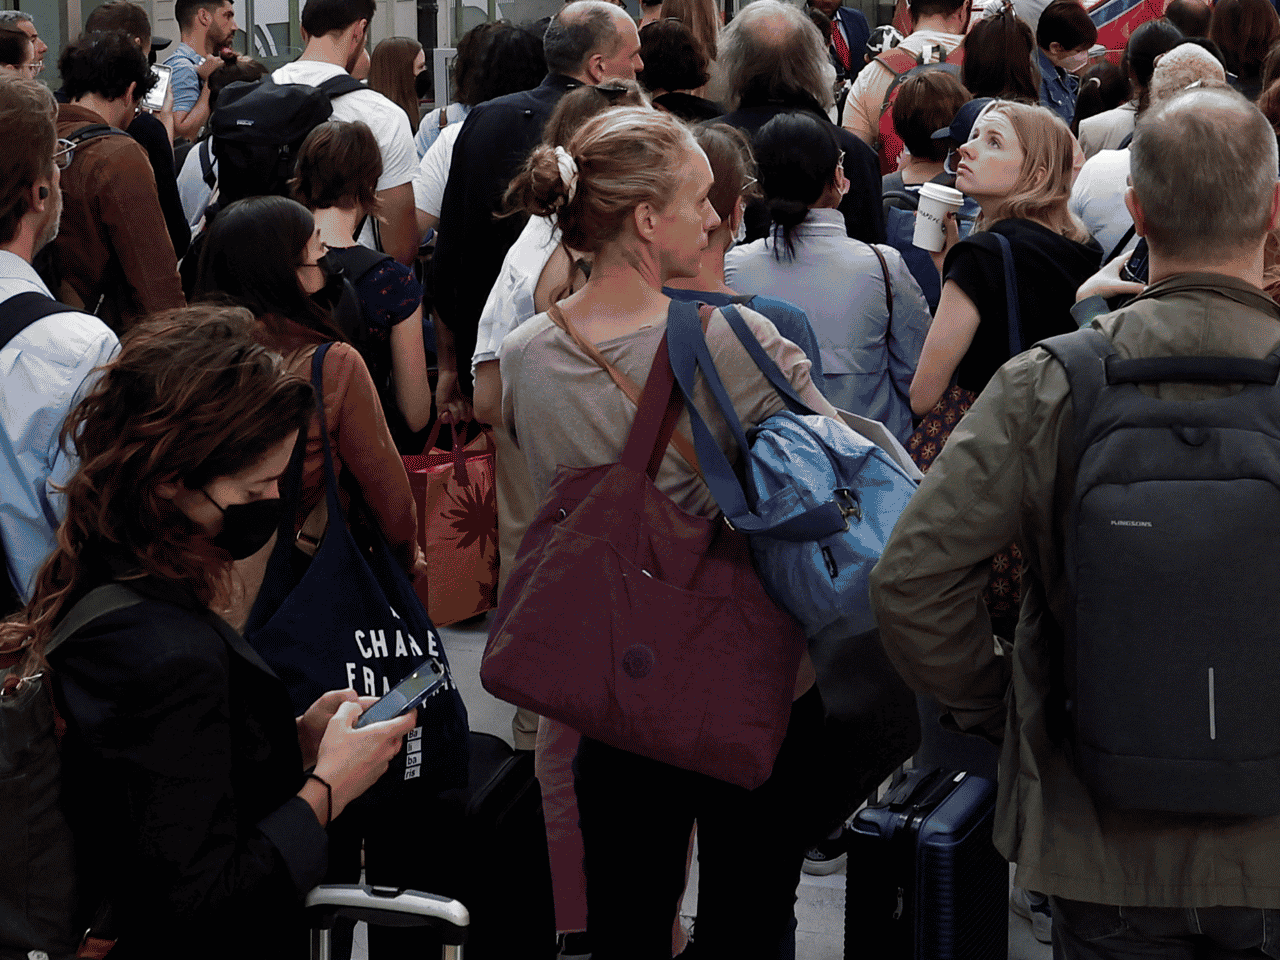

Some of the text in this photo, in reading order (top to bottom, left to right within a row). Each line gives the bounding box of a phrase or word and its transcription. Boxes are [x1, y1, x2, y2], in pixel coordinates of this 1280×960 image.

[408, 729, 418, 738] Ba
[407, 756, 417, 765] ba
[405, 769, 415, 778] ris
